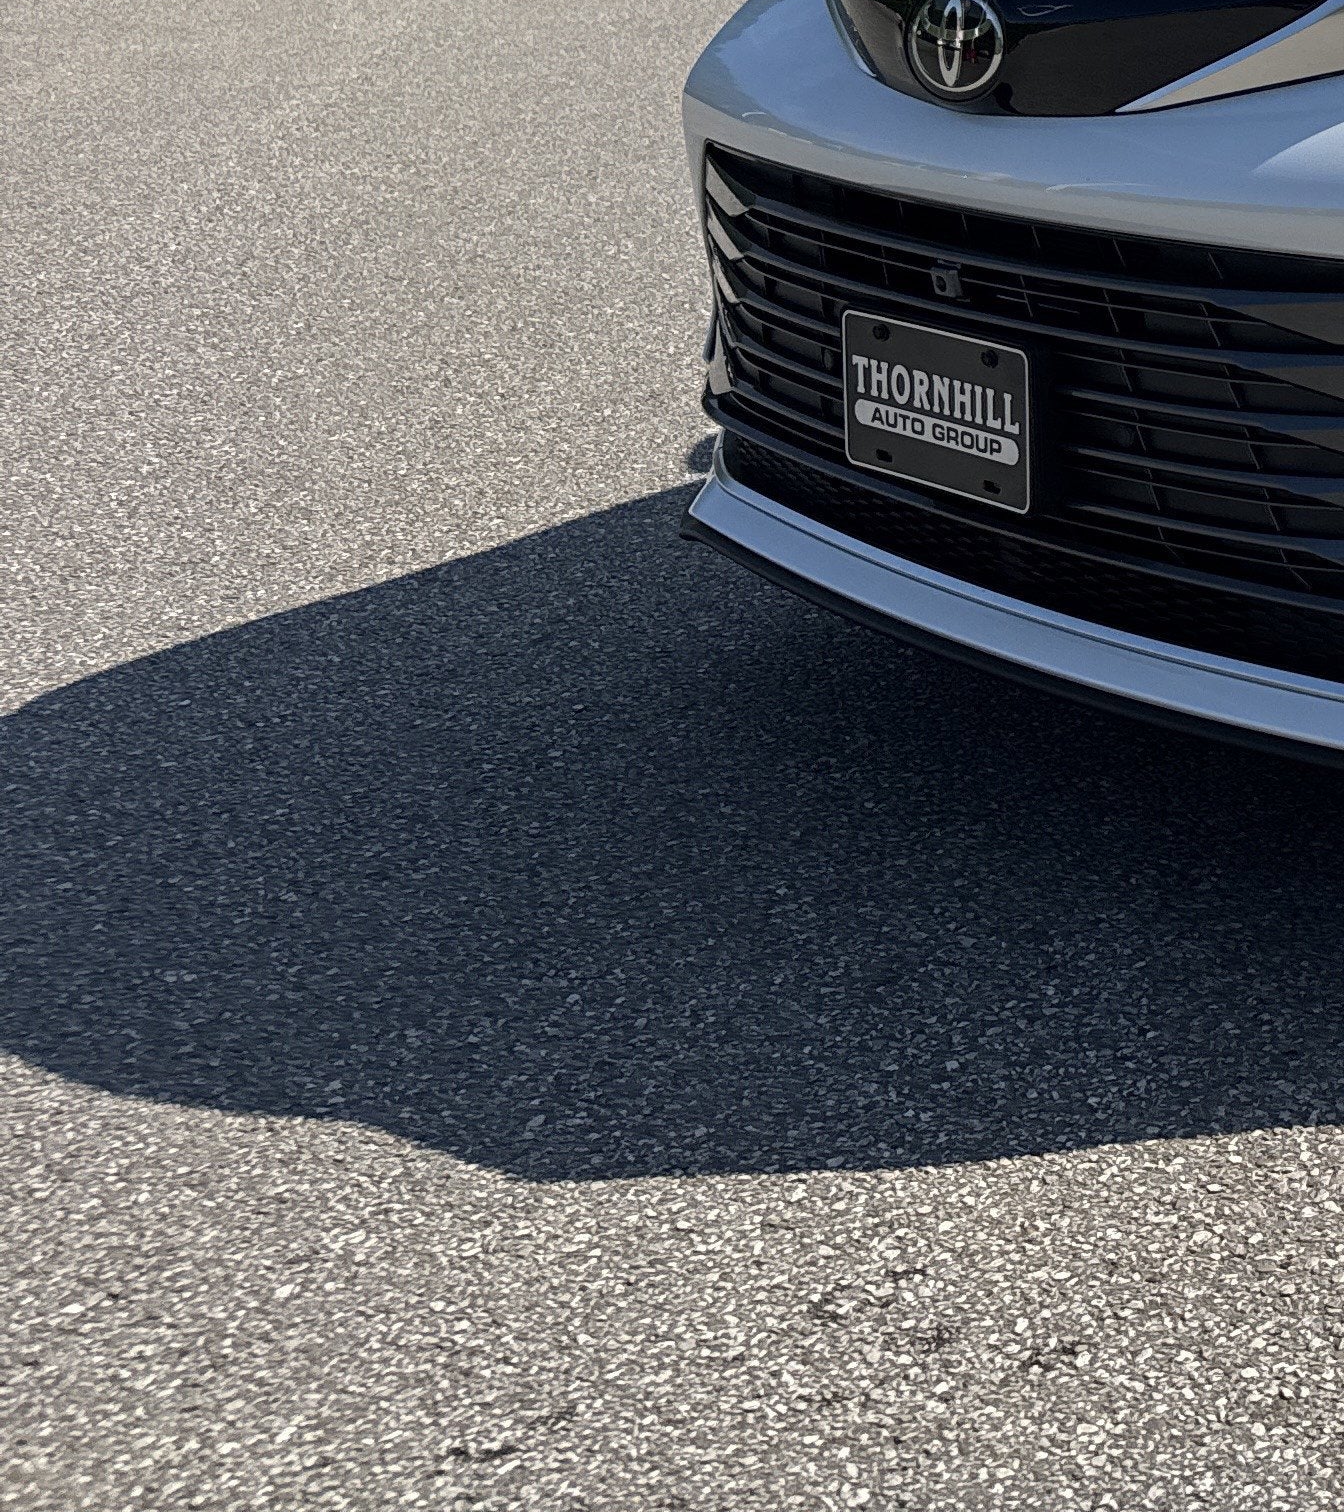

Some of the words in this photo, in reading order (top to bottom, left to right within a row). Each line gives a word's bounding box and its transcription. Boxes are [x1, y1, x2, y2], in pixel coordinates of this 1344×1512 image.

[852, 354, 1020, 435] THORNHILL
[871, 407, 925, 434] AUTO
[932, 423, 1002, 456] GROUP
